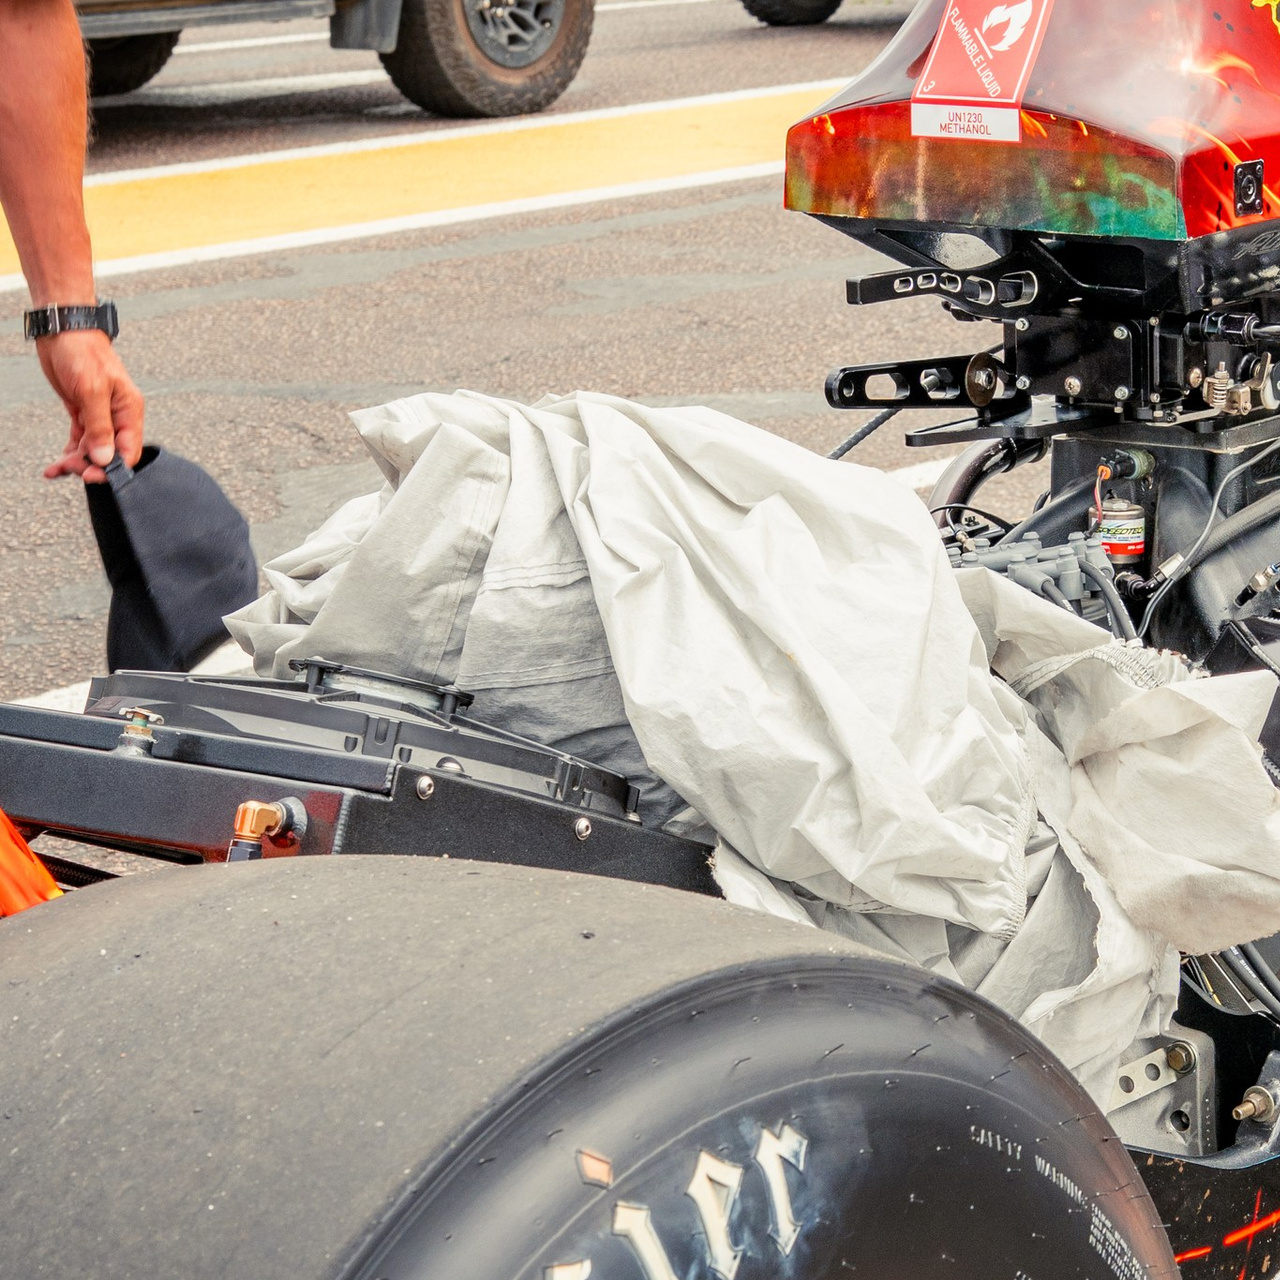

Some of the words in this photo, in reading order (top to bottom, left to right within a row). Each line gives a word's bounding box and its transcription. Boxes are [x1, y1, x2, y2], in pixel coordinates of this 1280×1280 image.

[949, 6, 985, 67] FLAMMABLE
[976, 61, 1002, 98] LIQUID
[923, 81, 936, 93] 3
[948, 112, 983, 124] UN1230
[939, 123, 992, 136] METHANOL
